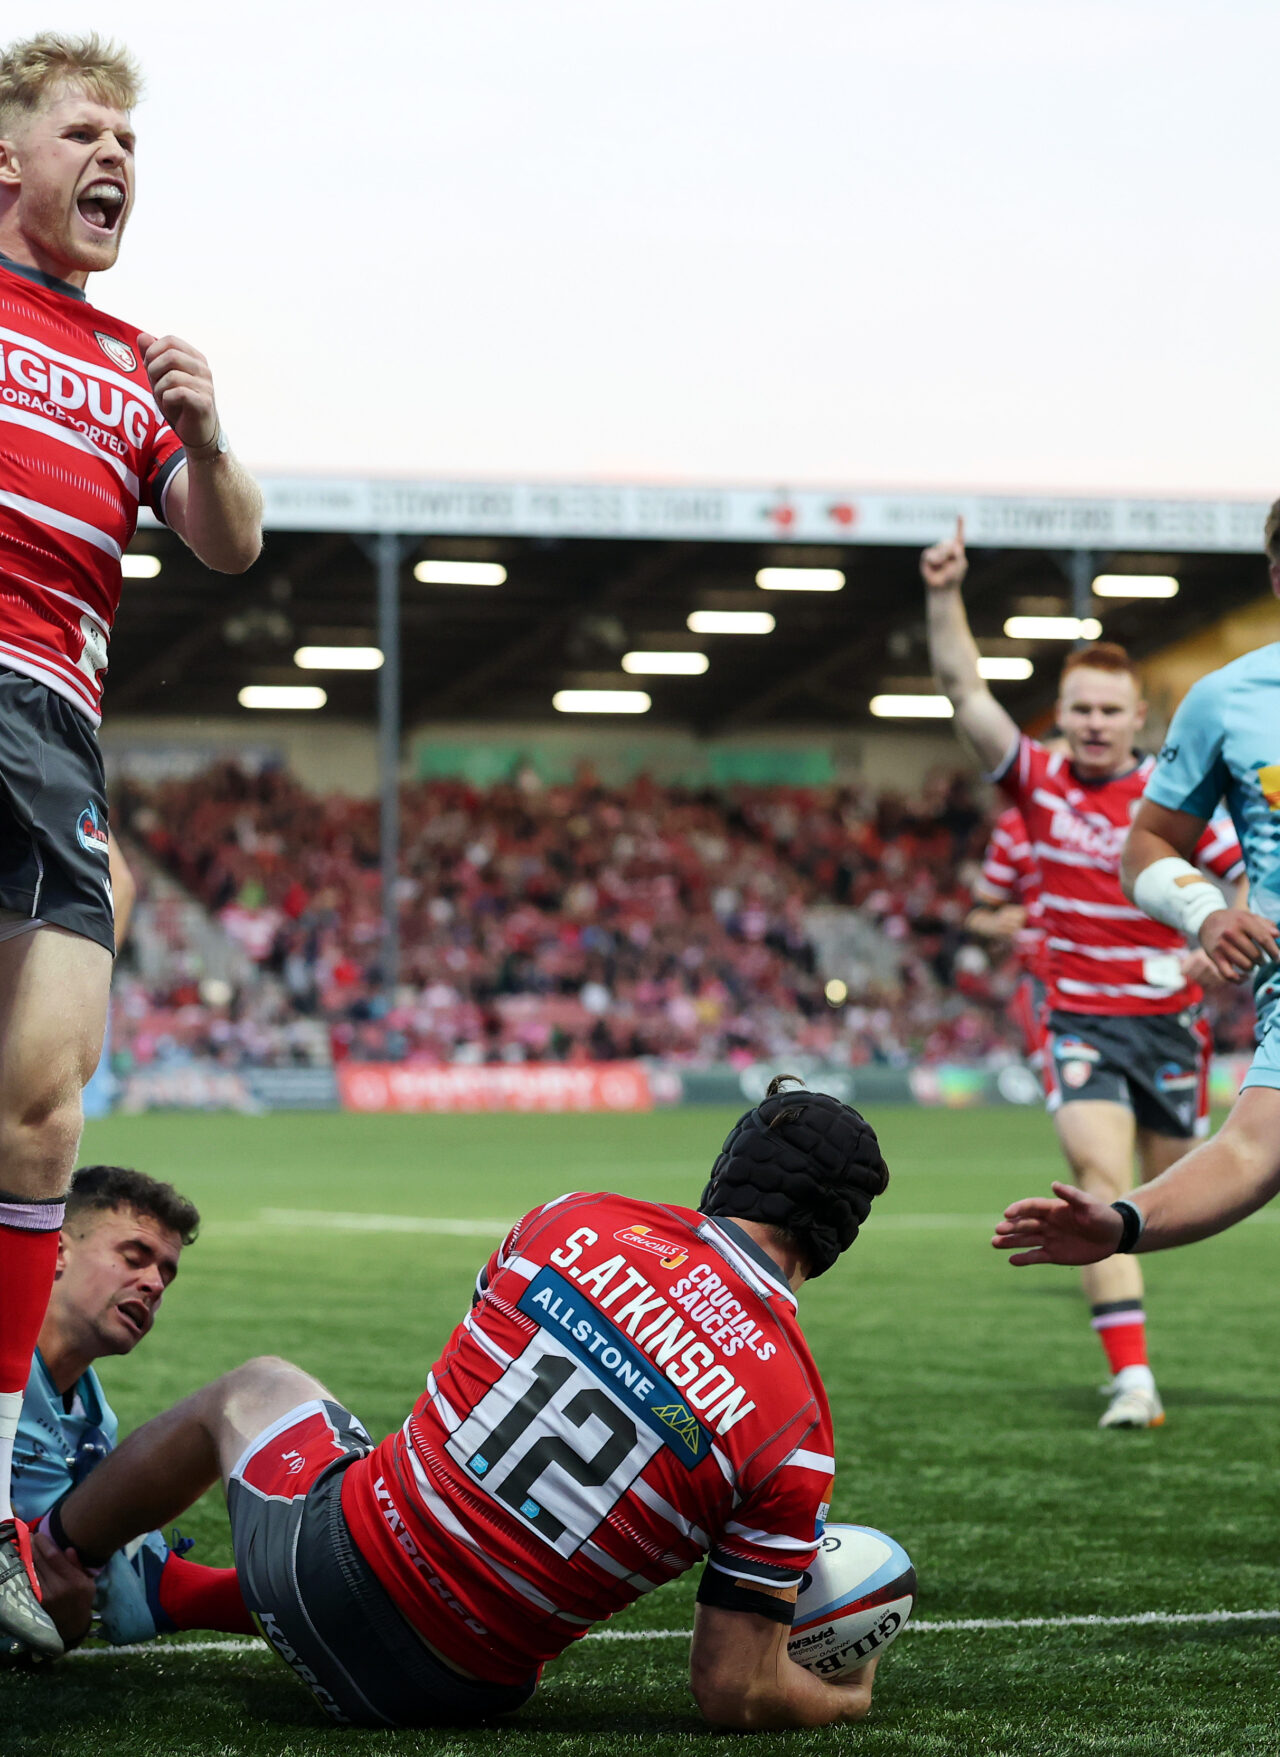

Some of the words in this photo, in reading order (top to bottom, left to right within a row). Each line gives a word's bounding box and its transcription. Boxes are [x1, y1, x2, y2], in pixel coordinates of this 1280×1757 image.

[622, 1232, 682, 1256] CRUCIALS
[531, 1286, 656, 1402] ALLSTONE
[549, 1226, 756, 1437] S.ATKINSON
[668, 1277, 745, 1357] SAUCES
[688, 1263, 777, 1361] CRUCIALS
[464, 1354, 638, 1545] 12
